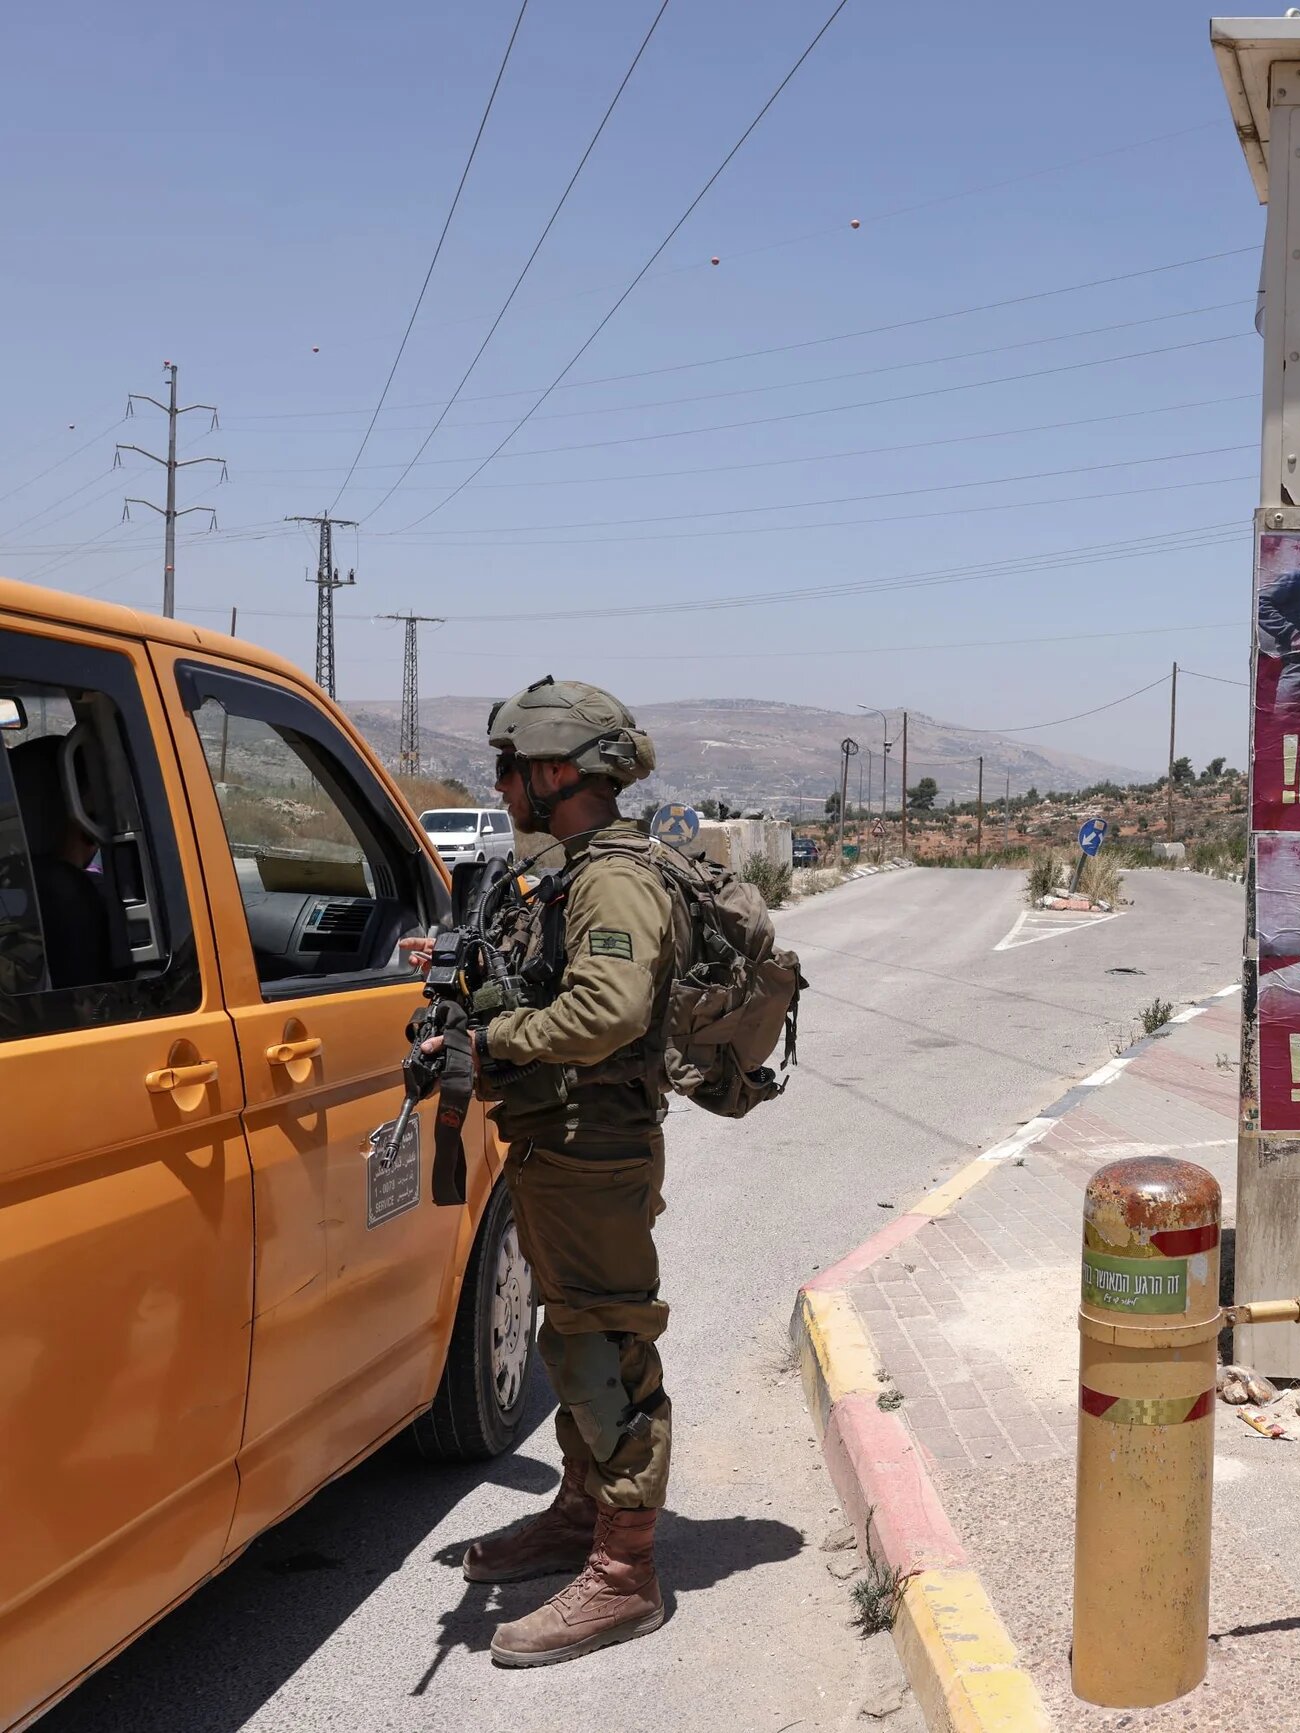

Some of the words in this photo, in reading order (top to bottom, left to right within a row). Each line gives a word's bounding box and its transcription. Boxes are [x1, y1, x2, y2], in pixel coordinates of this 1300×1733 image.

[1094, 1267, 1129, 1293] המאושר
[1134, 1275, 1162, 1295] הרגע
[1167, 1274, 1180, 1294] זה
